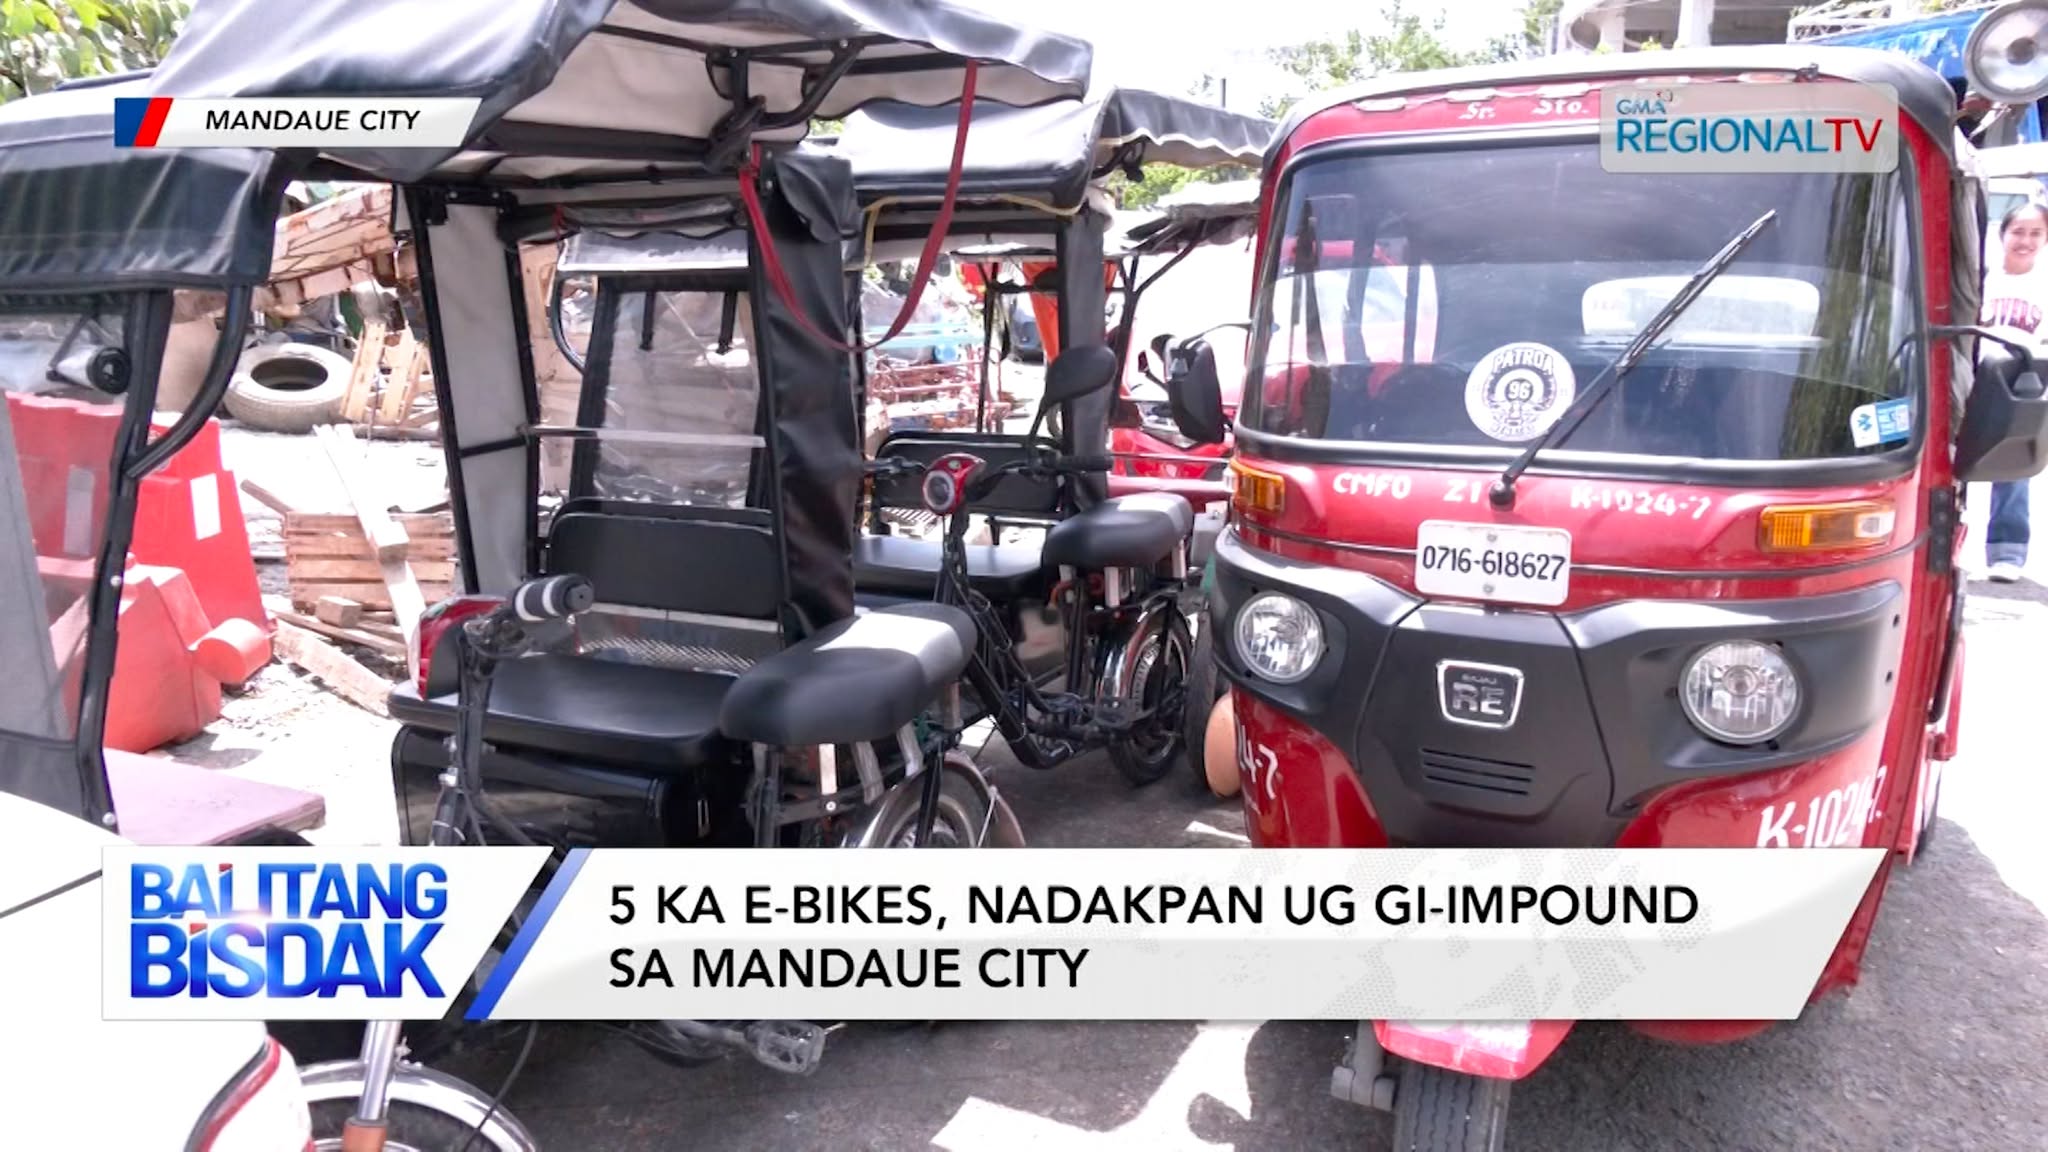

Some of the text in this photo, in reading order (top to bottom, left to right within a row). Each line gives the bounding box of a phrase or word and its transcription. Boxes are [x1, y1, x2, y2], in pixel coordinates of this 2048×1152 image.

[1508, 380, 1535, 401] 96
[1422, 545, 1566, 582] 0716-618627
[1453, 681, 1505, 716] RE
